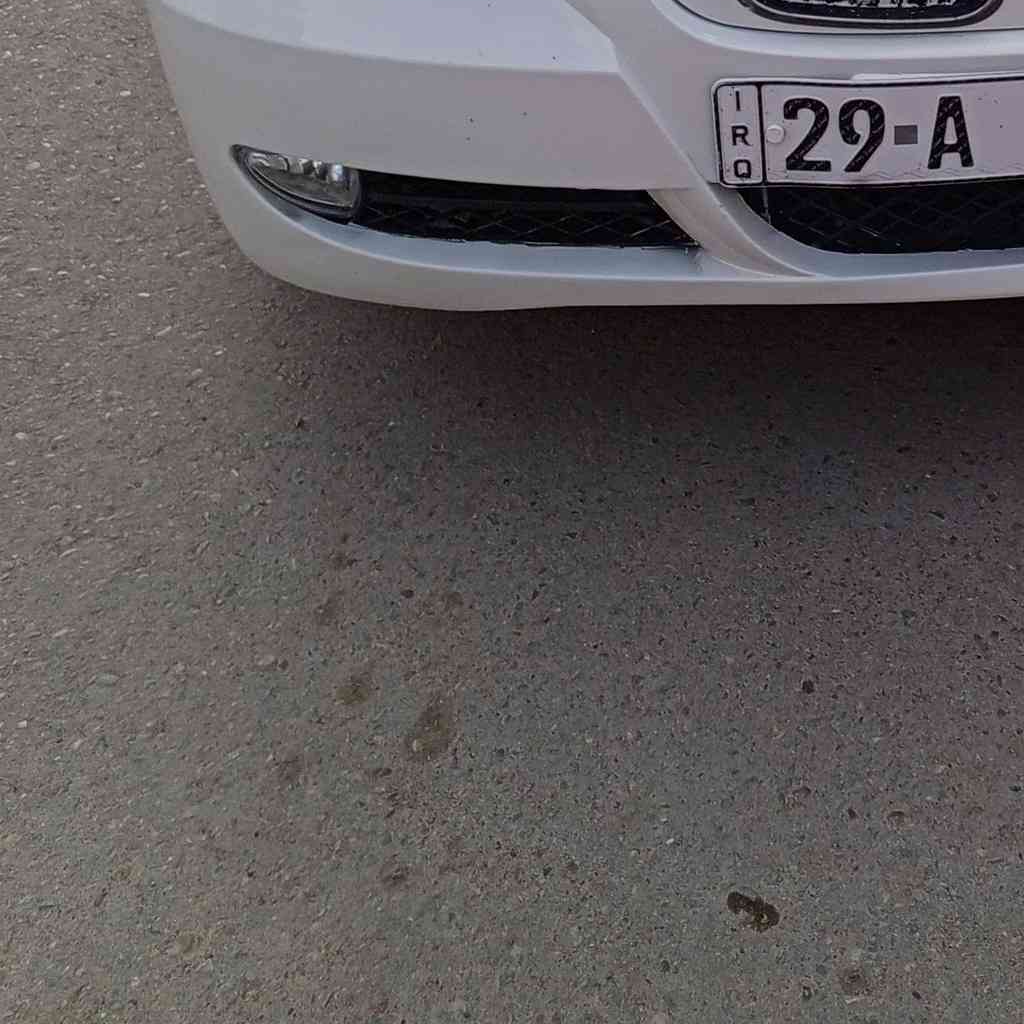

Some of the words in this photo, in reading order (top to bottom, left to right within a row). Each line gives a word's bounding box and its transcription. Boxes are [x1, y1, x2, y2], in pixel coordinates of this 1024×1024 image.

[730, 90, 753, 180] IRQ
[782, 97, 886, 173] 29
[927, 95, 975, 170] A
